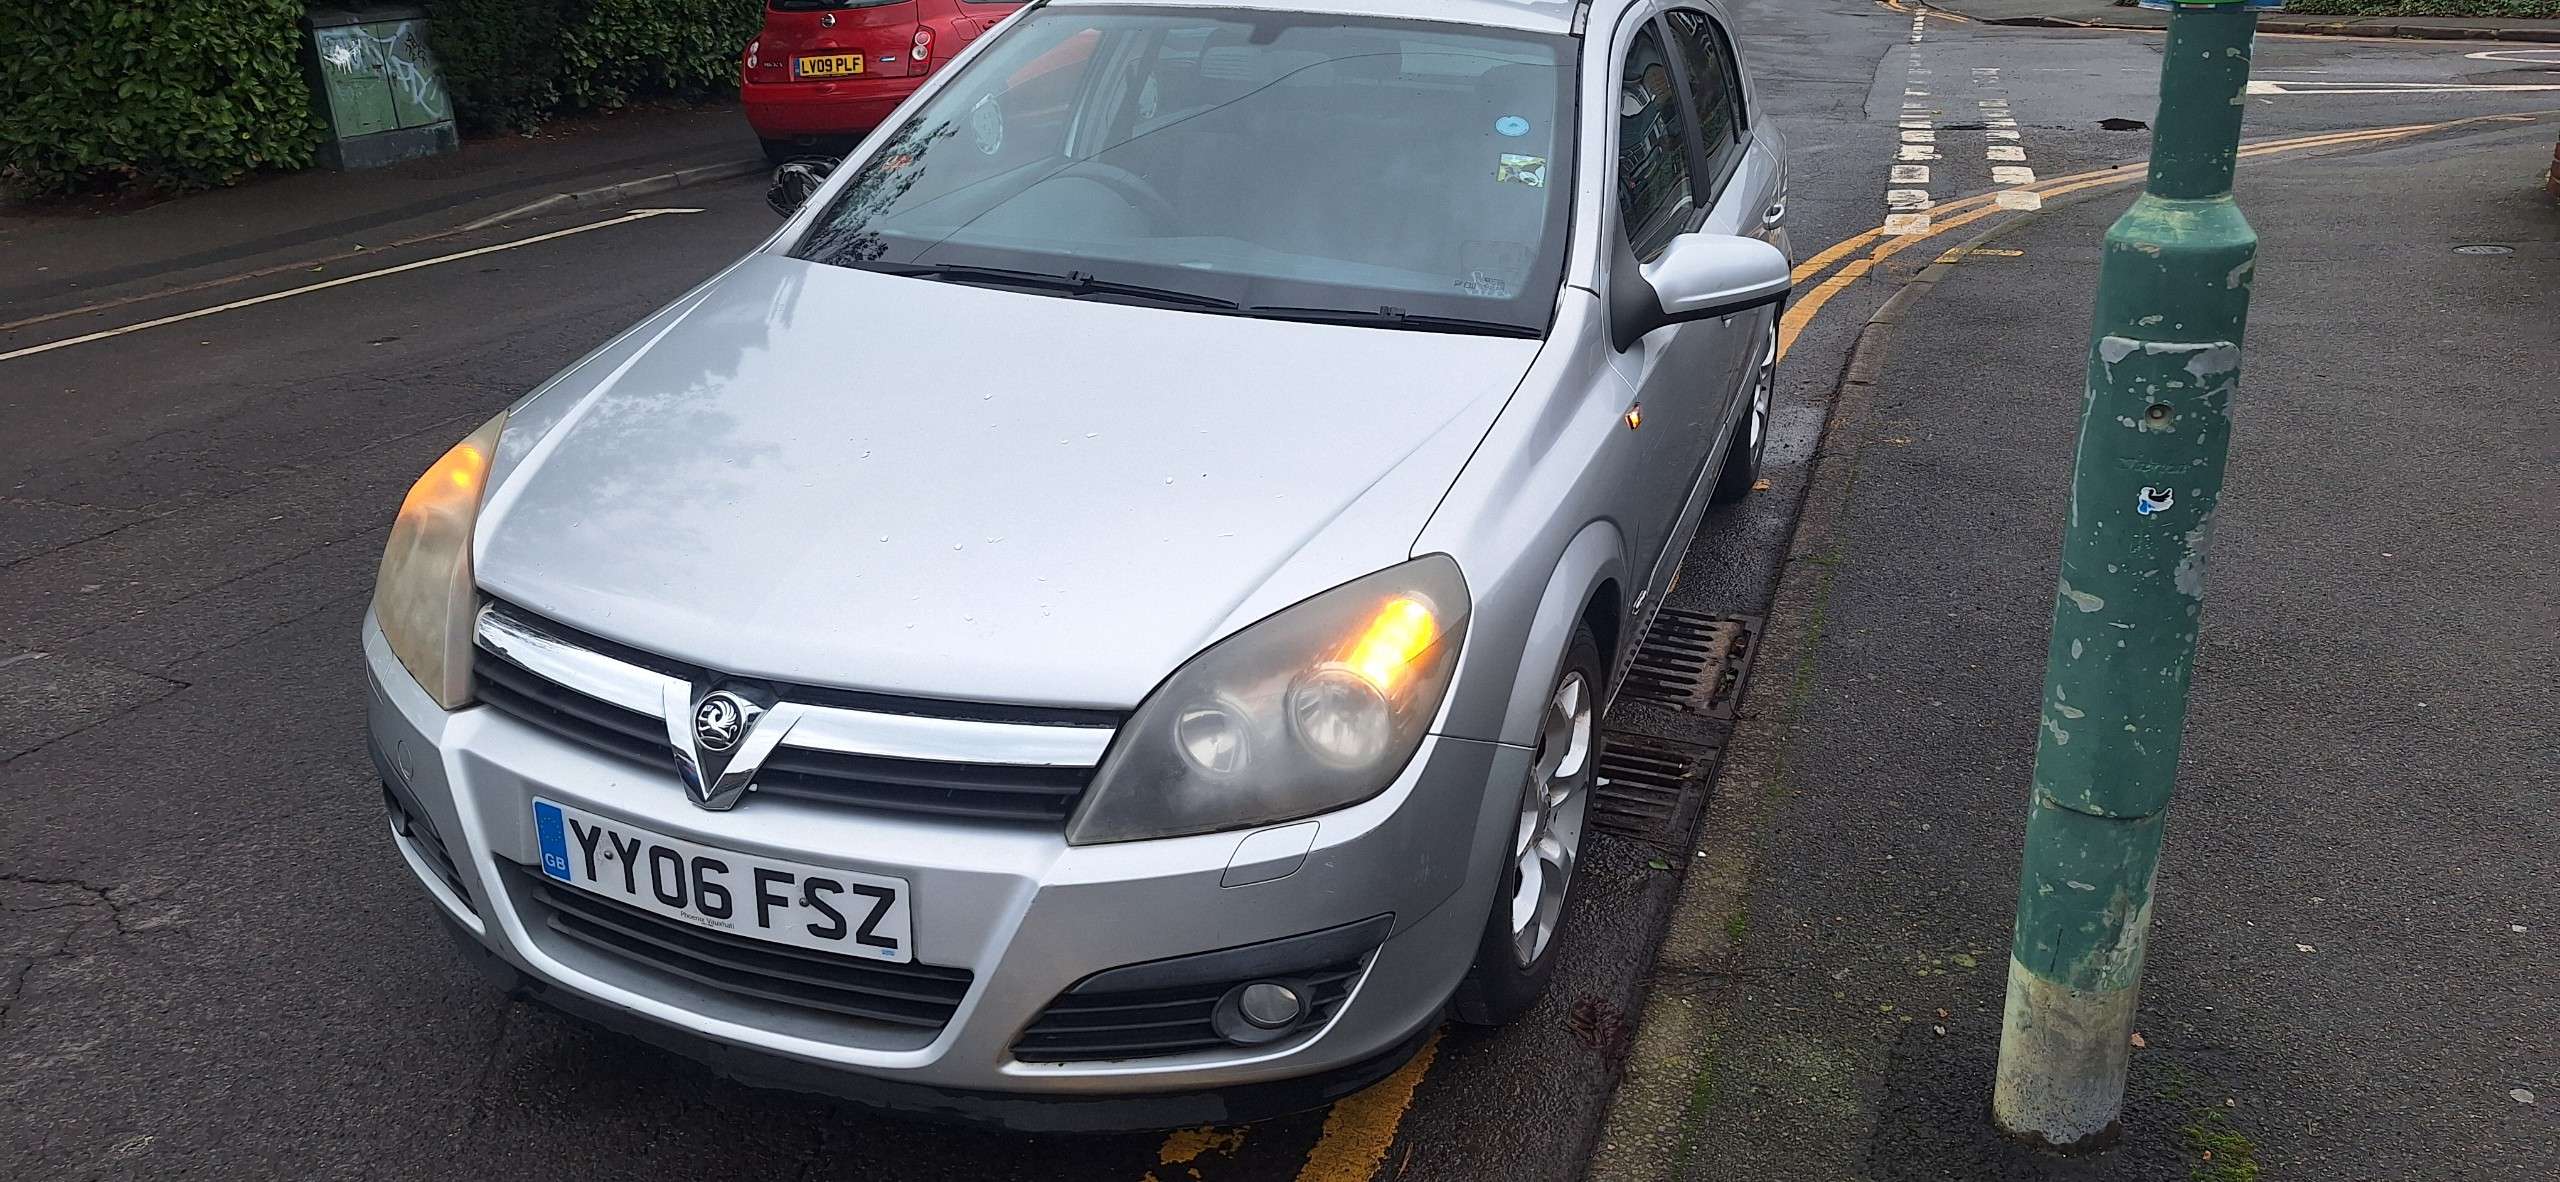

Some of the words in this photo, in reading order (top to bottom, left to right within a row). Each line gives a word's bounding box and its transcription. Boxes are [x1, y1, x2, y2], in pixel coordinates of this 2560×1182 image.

[802, 58, 833, 74] LV09
[836, 57, 861, 72] PLF
[544, 852, 566, 871] GB
[568, 817, 733, 920] YY06
[753, 866, 899, 950] FSZ
